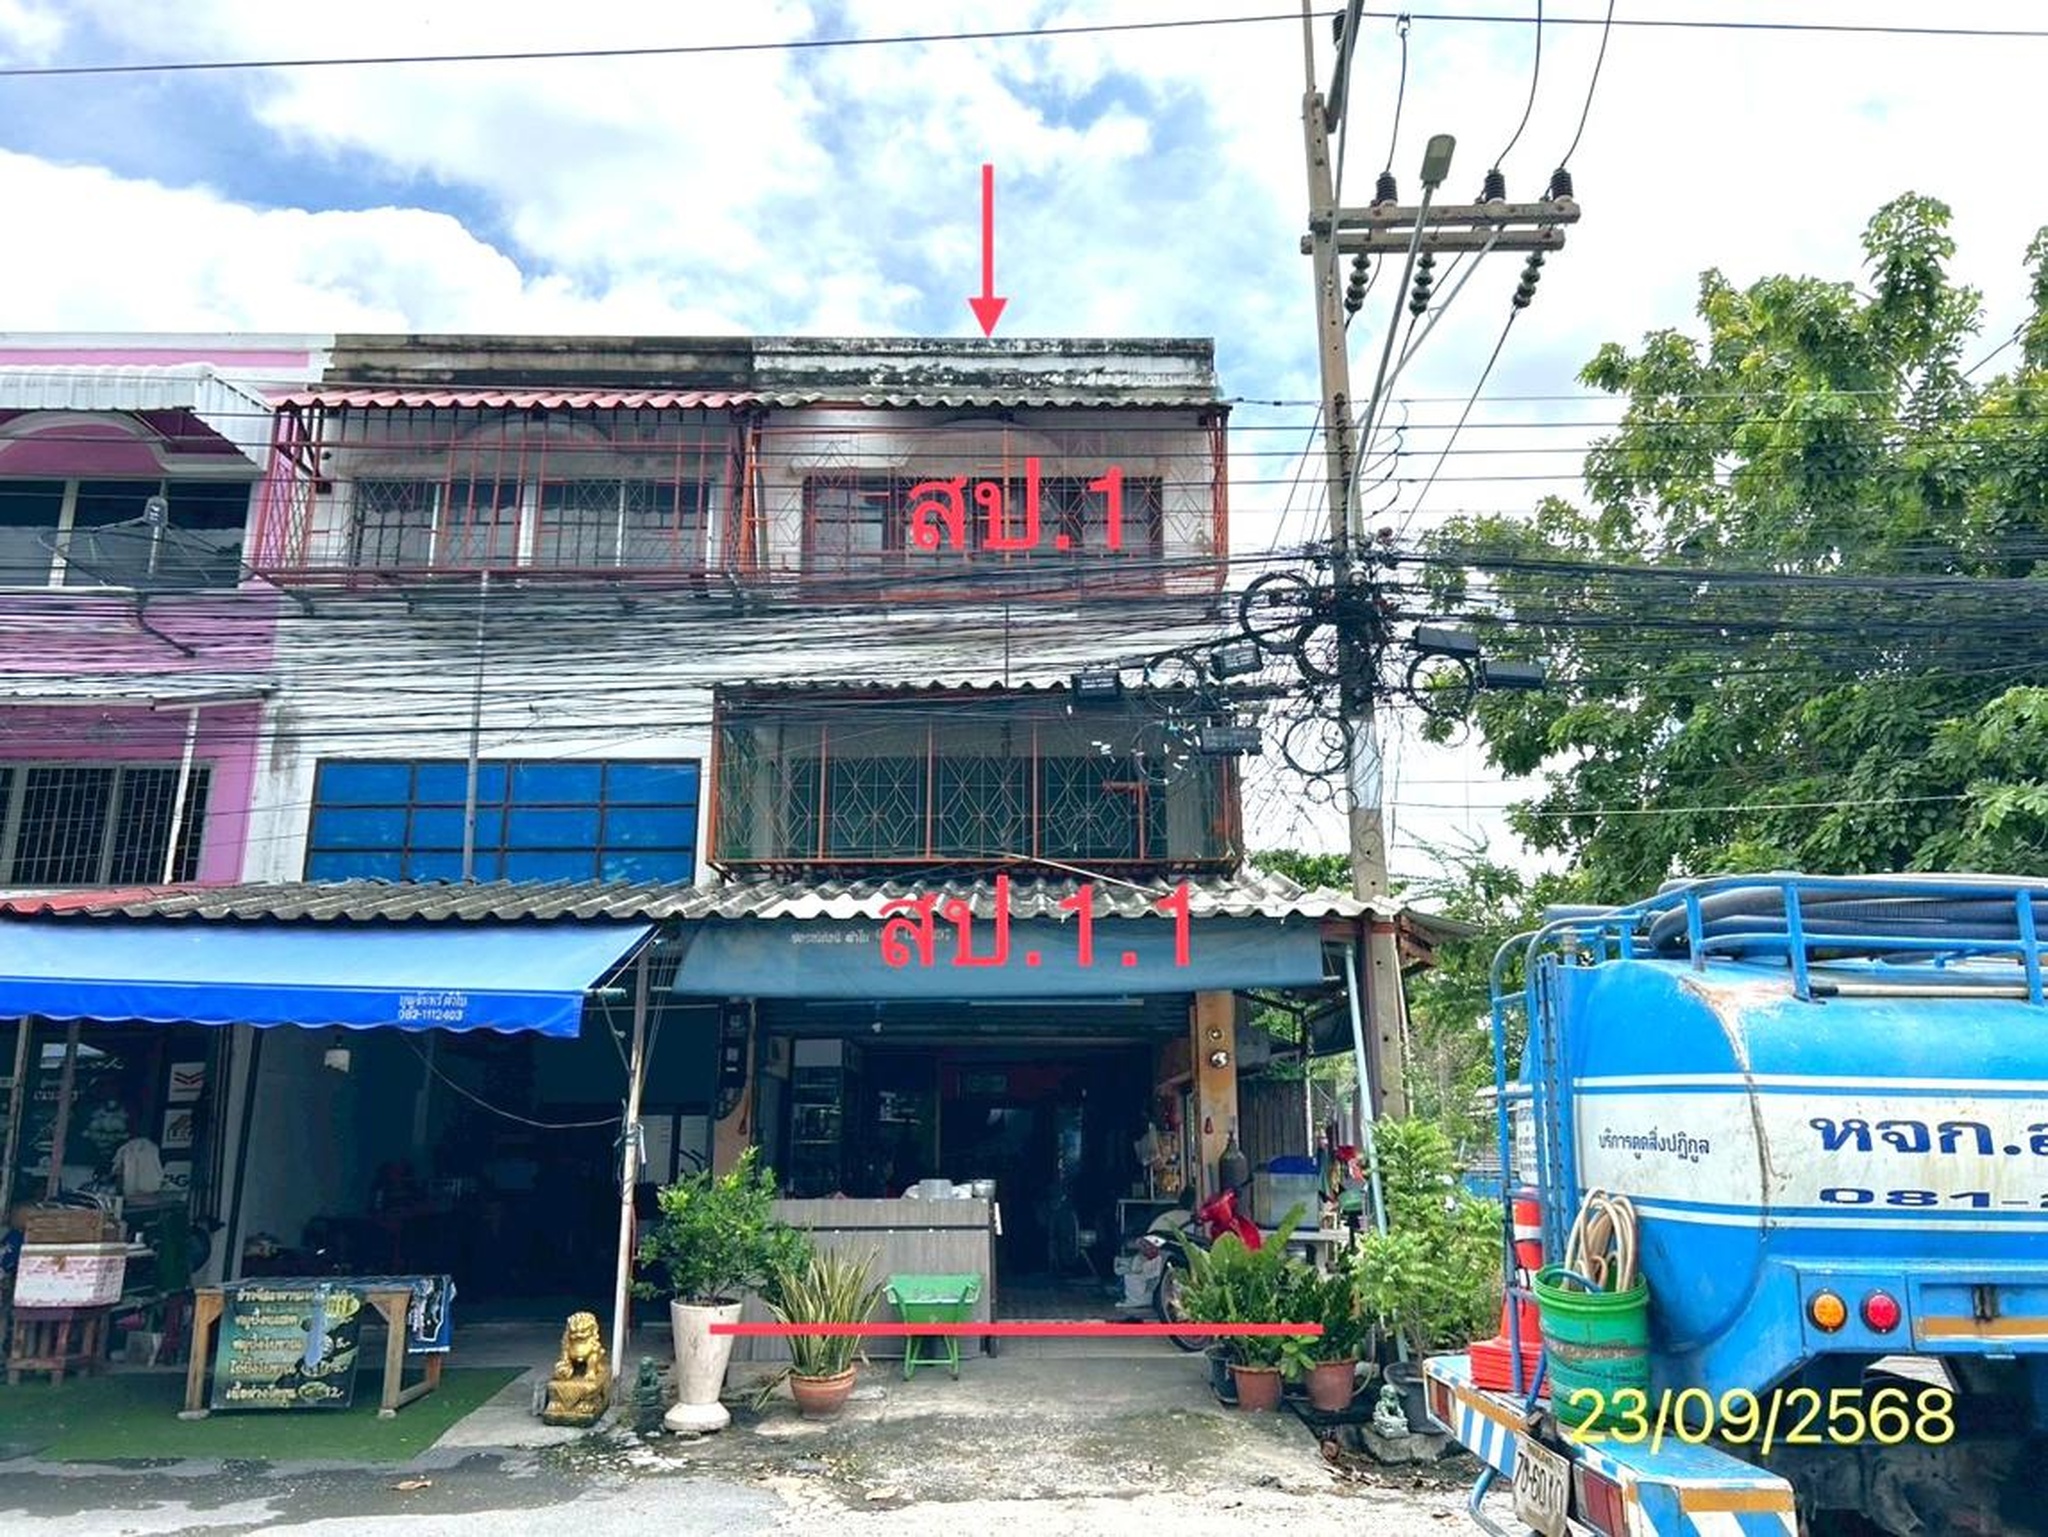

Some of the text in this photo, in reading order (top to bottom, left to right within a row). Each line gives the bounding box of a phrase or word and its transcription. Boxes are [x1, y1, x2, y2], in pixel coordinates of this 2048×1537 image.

[1599, 1126, 1711, 1163] บริการดูดสิ่งปฏิกูล
[1819, 1187, 2048, 1208] 081-
